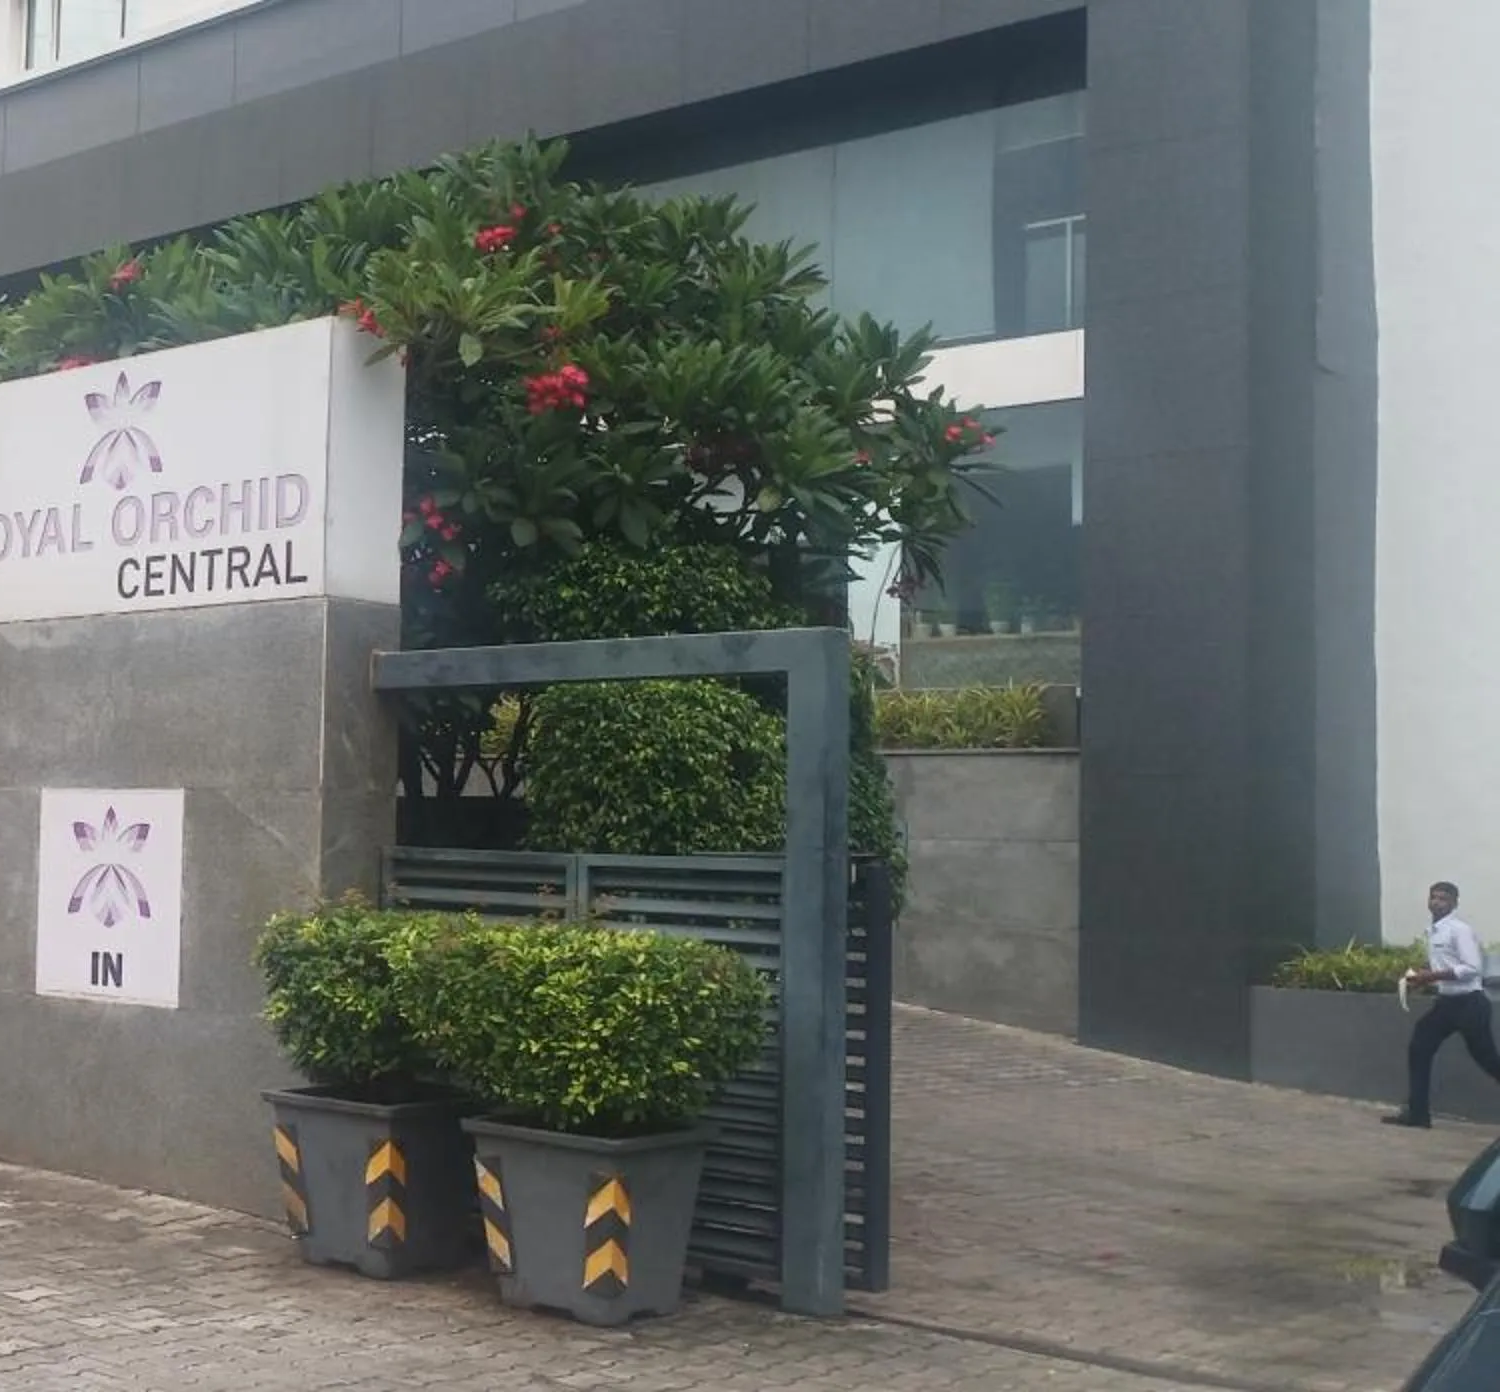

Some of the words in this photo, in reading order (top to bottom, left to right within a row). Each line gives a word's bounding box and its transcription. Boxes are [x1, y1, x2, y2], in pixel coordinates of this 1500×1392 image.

[111, 473, 310, 547] ORCHID
[117, 540, 308, 599] CENTRAL
[90, 951, 123, 987] IN
